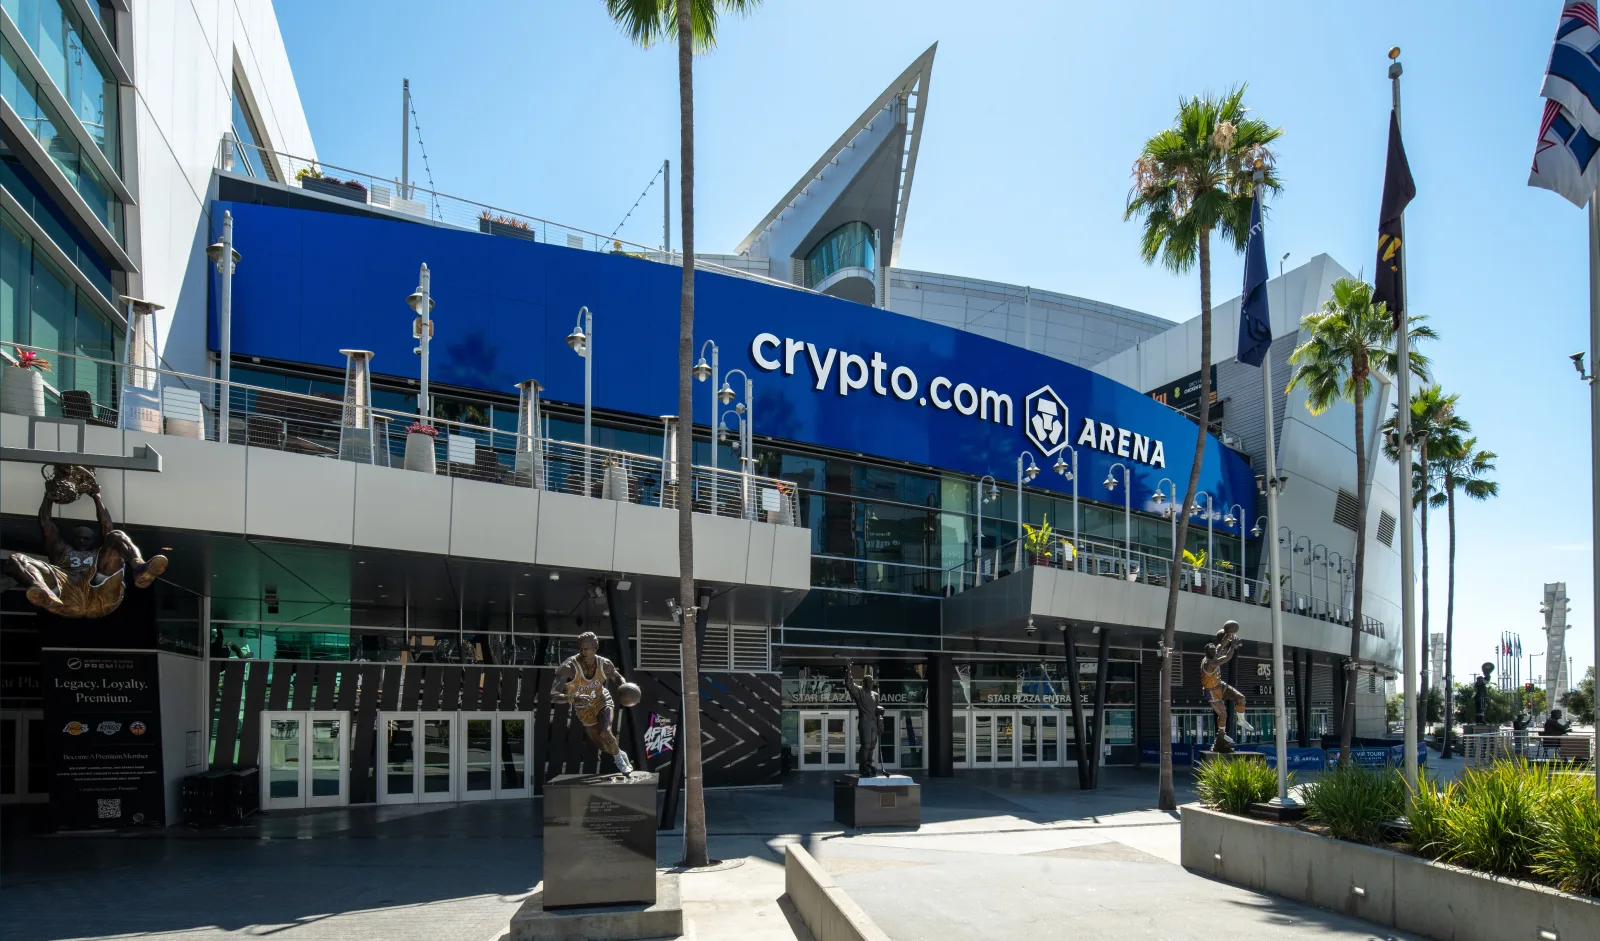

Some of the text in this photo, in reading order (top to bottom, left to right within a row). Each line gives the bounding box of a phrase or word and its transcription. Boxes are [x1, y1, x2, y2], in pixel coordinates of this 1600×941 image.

[752, 332, 1166, 469] crypto.com ARENA
[69, 556, 94, 568] 34
[1257, 663, 1271, 680] axs
[54, 677, 148, 691] Legacy. Loyalty.
[1259, 685, 1273, 695] BOX
[76, 692, 132, 703] Premium.
[792, 693, 818, 702] STAR
[820, 693, 852, 702] PLAZA
[987, 694, 1089, 703] STAR PLAZA ENTRACE
[123, 752, 149, 760] Member
